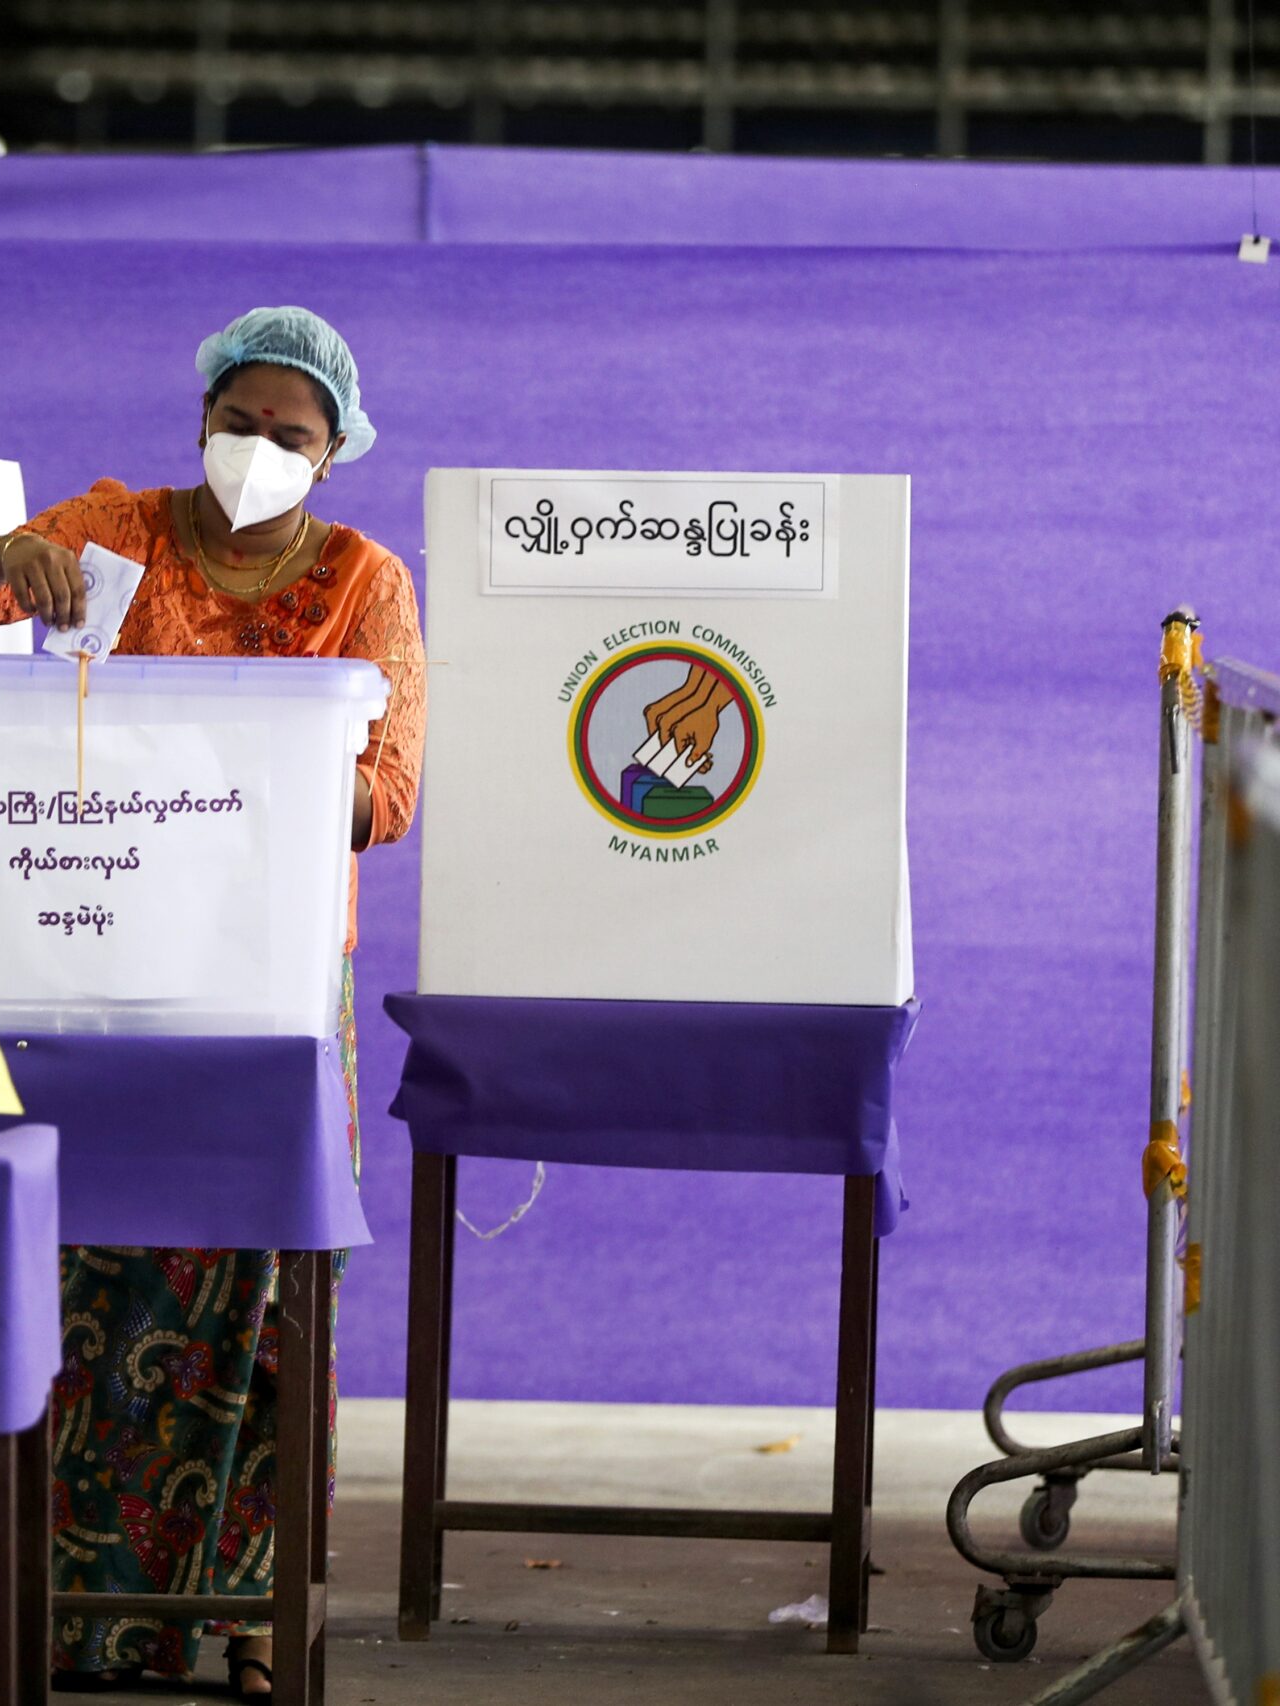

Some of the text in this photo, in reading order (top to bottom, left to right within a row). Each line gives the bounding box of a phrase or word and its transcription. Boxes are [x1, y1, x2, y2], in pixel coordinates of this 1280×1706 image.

[557, 621, 777, 709] UNION ELECTION COMMISSION
[8, 846, 140, 880] ကိုယ်စားလှယ်
[608, 835, 720, 862] MYANMAR
